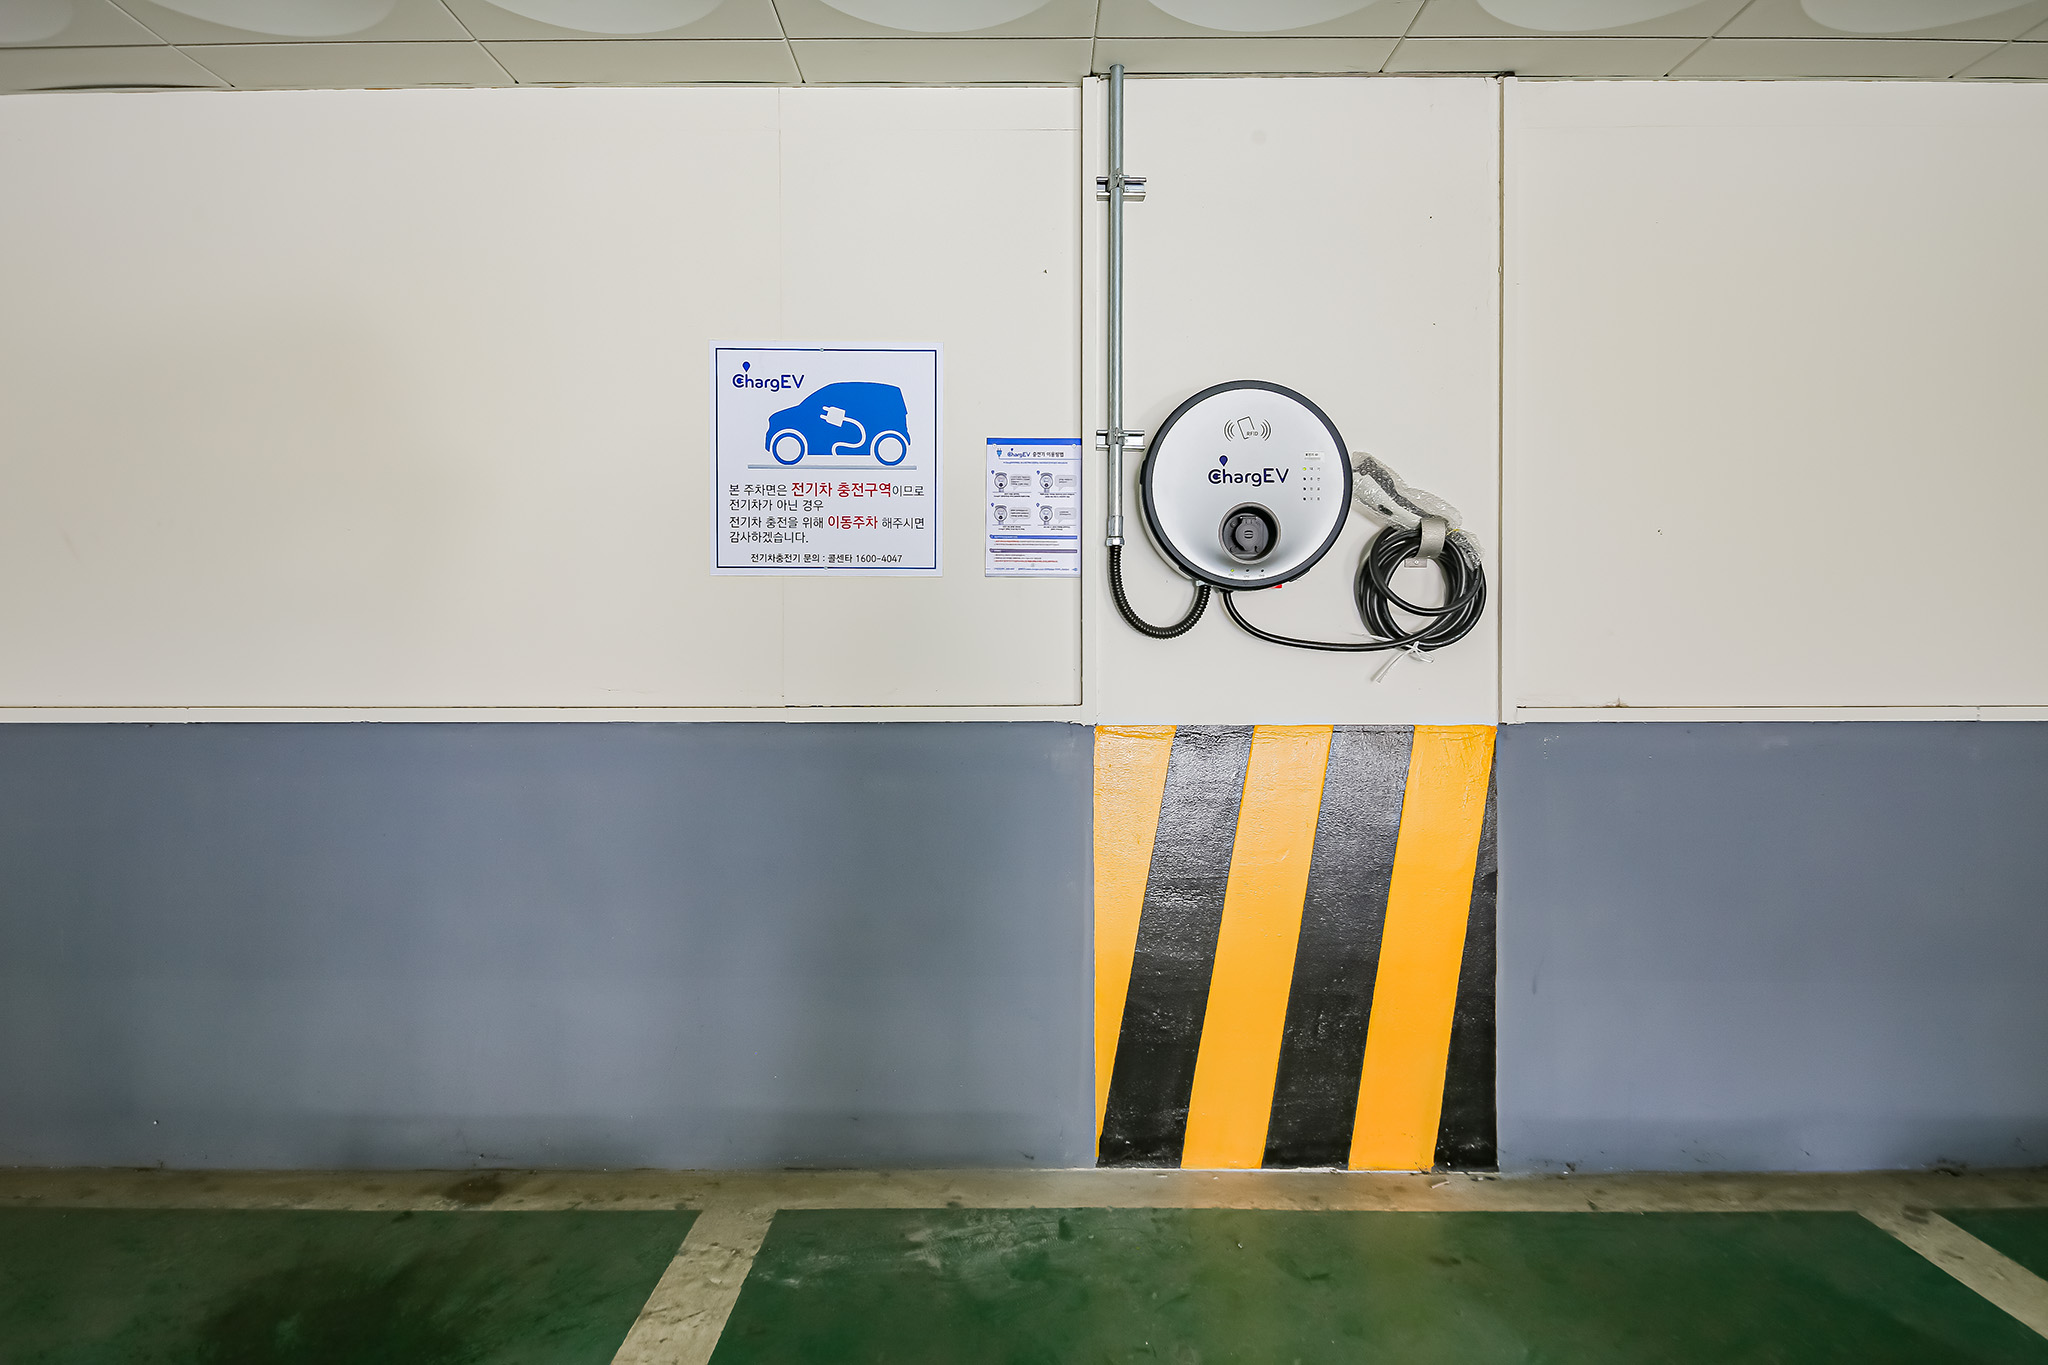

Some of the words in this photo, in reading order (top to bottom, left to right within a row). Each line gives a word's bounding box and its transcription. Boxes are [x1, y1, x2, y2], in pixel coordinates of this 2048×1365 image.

[732, 374, 805, 392] ChargEV
[1208, 468, 1290, 487] ChargEV
[728, 484, 740, 496] 본
[743, 484, 788, 497] 주차면은
[790, 482, 833, 498] 전기차
[836, 482, 925, 498] 충전구역이므로
[729, 499, 773, 511] 전기차가
[776, 499, 799, 512] 아닌
[802, 499, 824, 512] 경우
[729, 516, 762, 529] 전기차
[765, 516, 799, 529] 충전을
[802, 516, 824, 529] 위해
[827, 515, 878, 530] 이동주차
[881, 516, 925, 530] 해주시면
[729, 531, 809, 544] 감사하겠습니다.
[750, 553, 801, 563] 전기차충전기
[803, 553, 820, 563] 문의
[855, 554, 903, 563] 1600-4047
